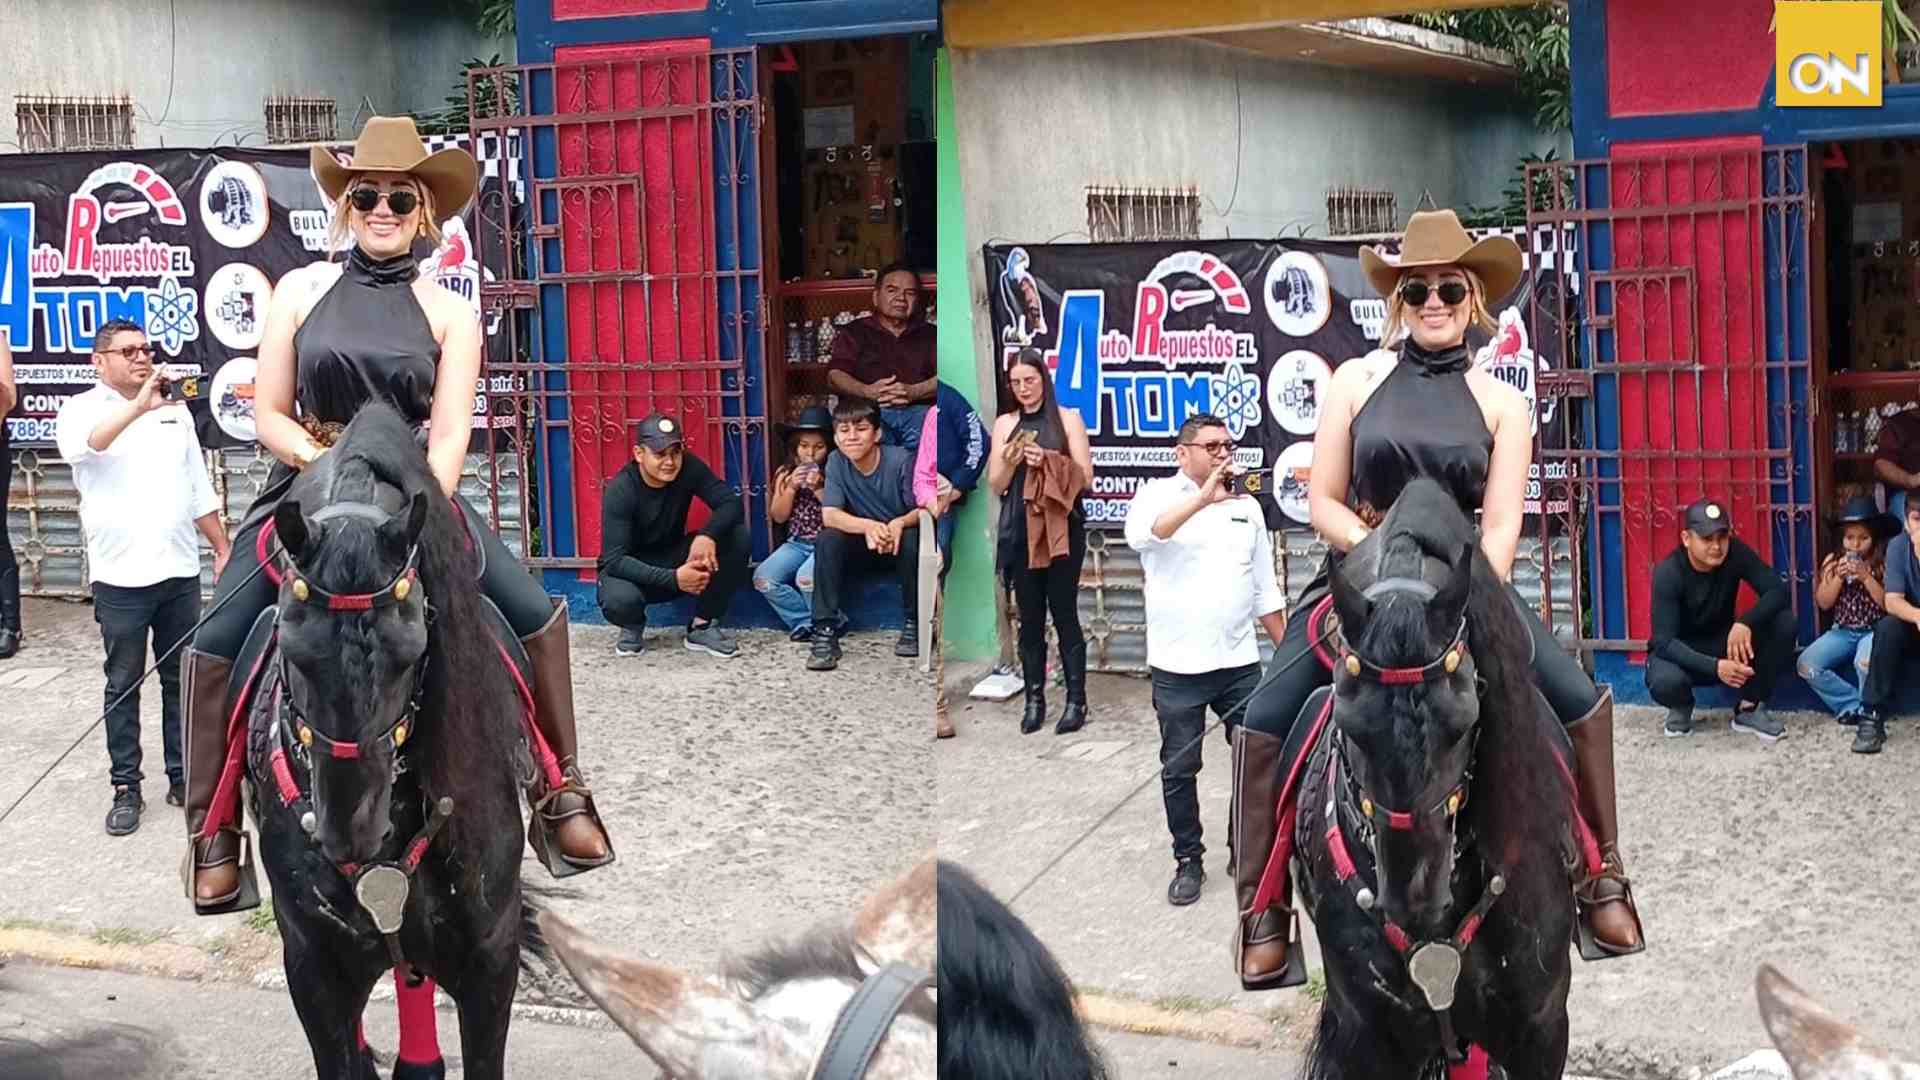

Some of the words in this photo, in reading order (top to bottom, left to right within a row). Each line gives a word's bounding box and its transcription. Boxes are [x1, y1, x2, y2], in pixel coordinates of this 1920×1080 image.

[67, 197, 169, 279] Repuestos
[171, 251, 190, 271] EL
[1135, 285, 1233, 367] Repuestos
[1236, 343, 1254, 358] EL
[13, 368, 64, 379] EPUESTOS
[66, 368, 73, 378] Y
[1133, 452, 1140, 461] Y
